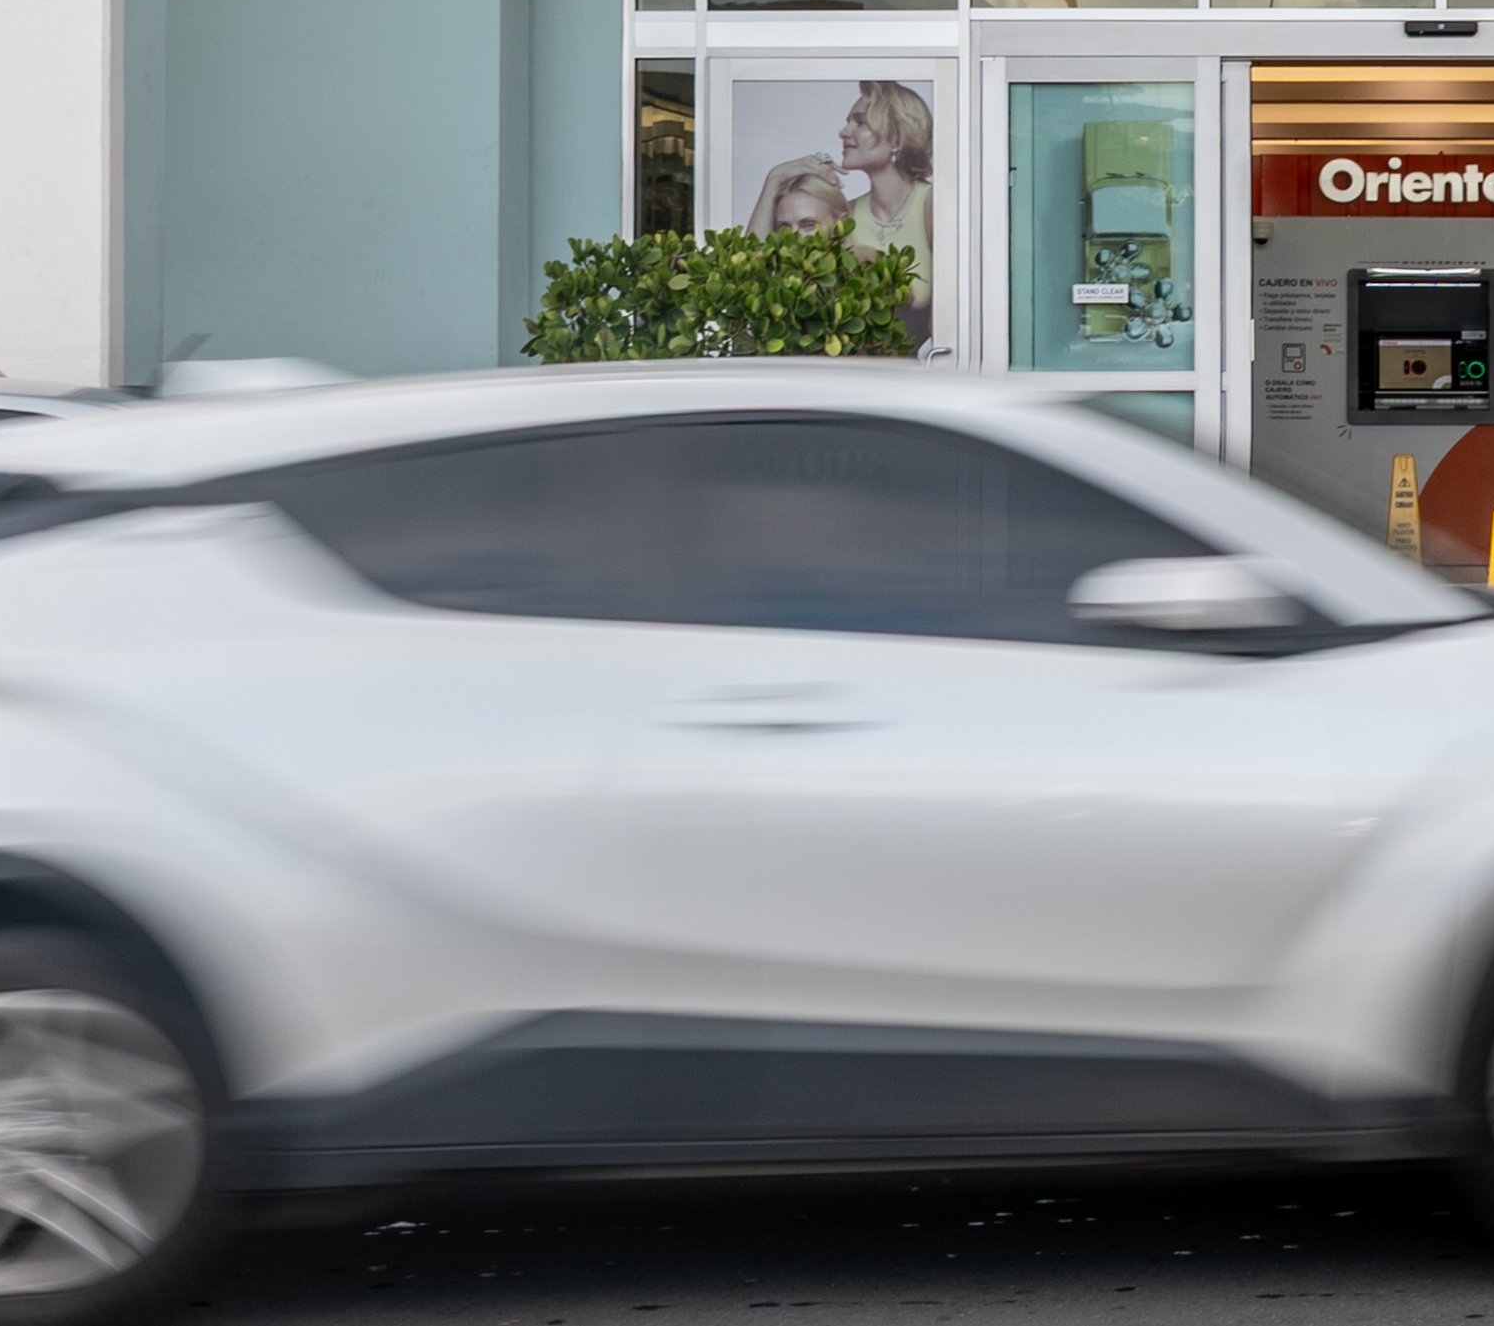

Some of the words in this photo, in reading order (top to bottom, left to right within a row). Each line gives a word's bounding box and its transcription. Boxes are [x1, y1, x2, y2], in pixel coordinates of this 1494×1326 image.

[1258, 279, 1297, 287] CAJERO
[1300, 279, 1313, 287] EN
[1315, 279, 1338, 287] VIVO
